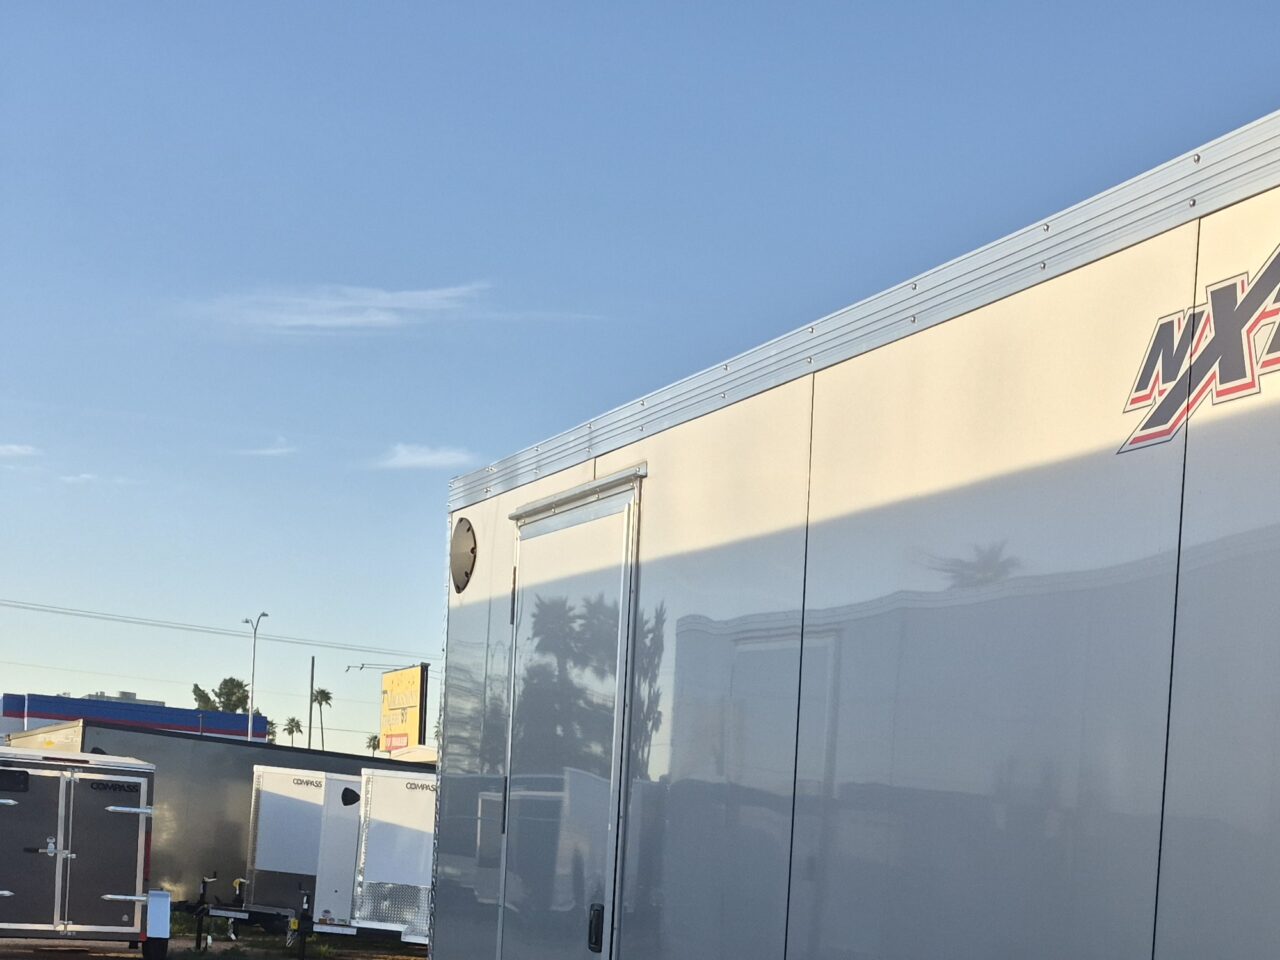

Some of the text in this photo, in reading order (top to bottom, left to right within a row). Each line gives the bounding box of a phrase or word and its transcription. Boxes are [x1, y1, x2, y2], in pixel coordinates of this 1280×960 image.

[90, 782, 139, 793] COMPASS
[292, 778, 323, 788] COMPASS
[405, 782, 437, 792] COMPAS
